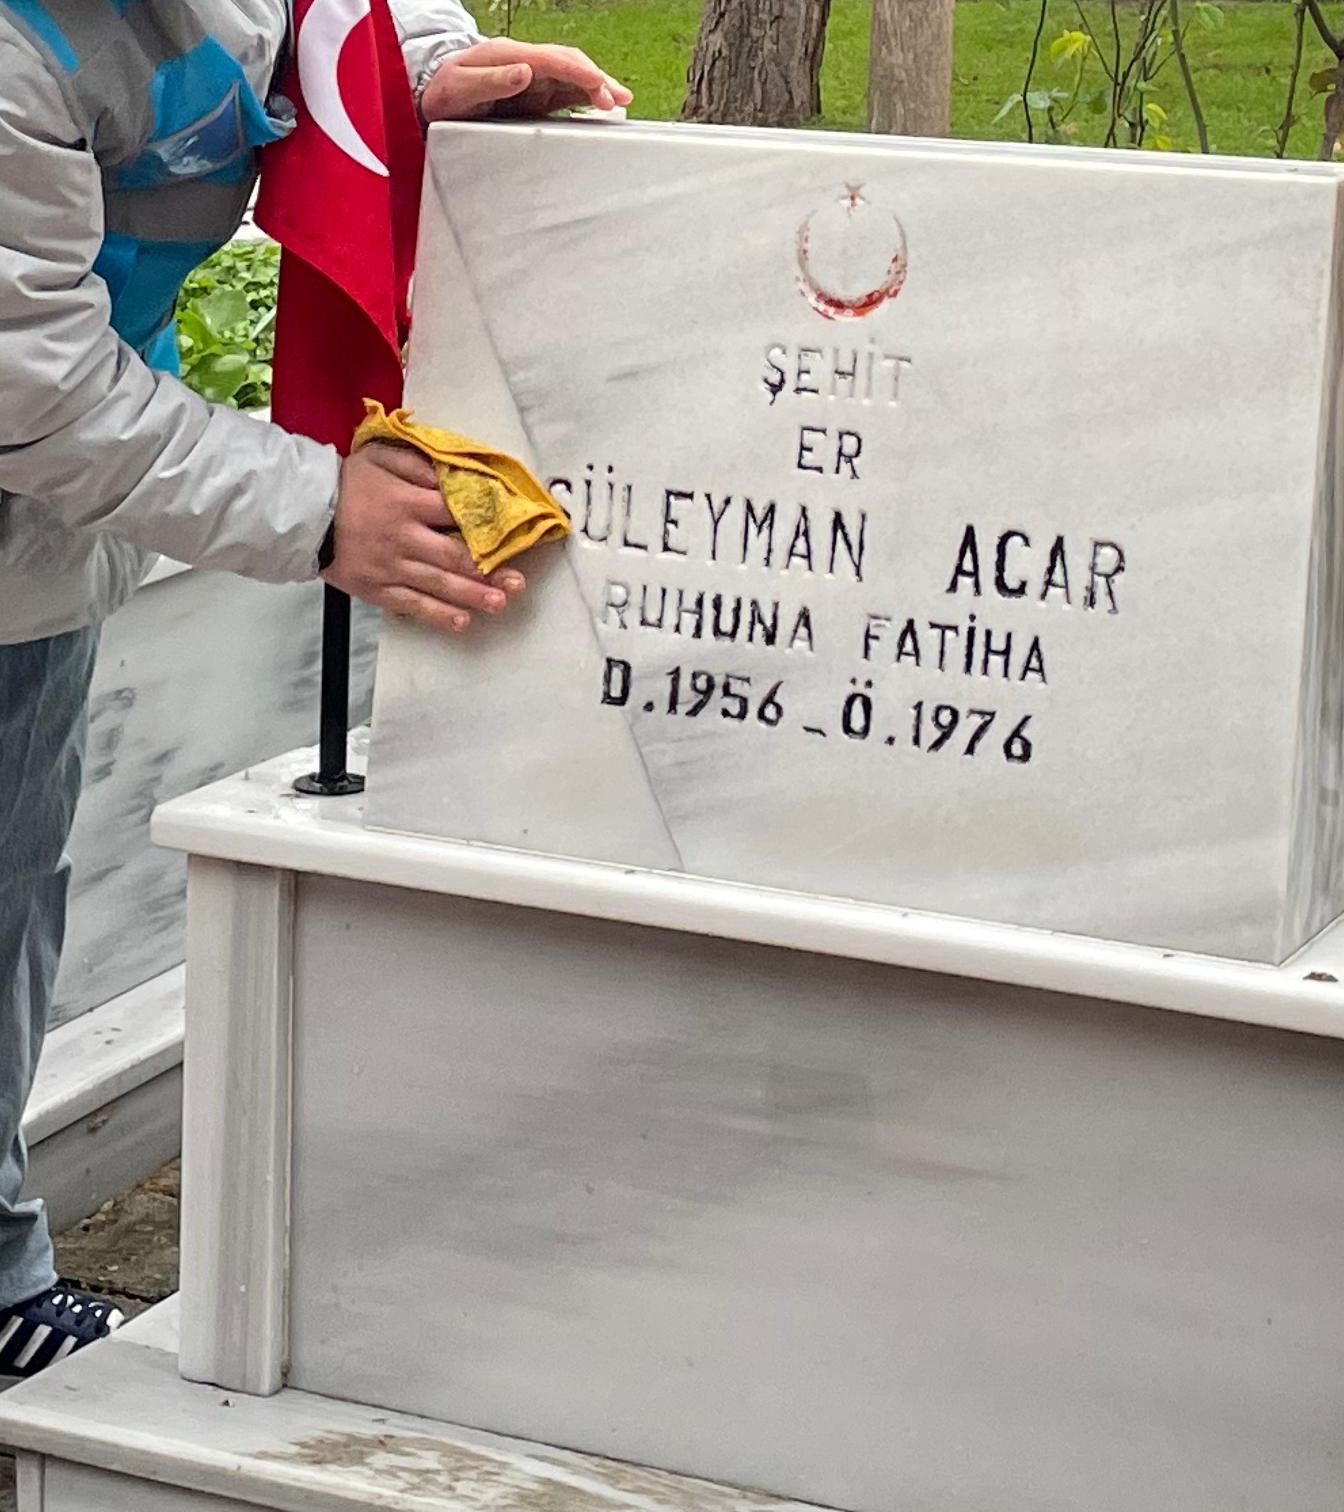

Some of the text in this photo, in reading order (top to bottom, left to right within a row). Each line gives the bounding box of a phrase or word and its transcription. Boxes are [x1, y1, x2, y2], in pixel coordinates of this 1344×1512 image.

[760, 336, 913, 406] ŞEHİT
[796, 425, 861, 481] ER
[946, 524, 1127, 615] ACAR
[602, 580, 1049, 686] RUHUNA FATİHA
